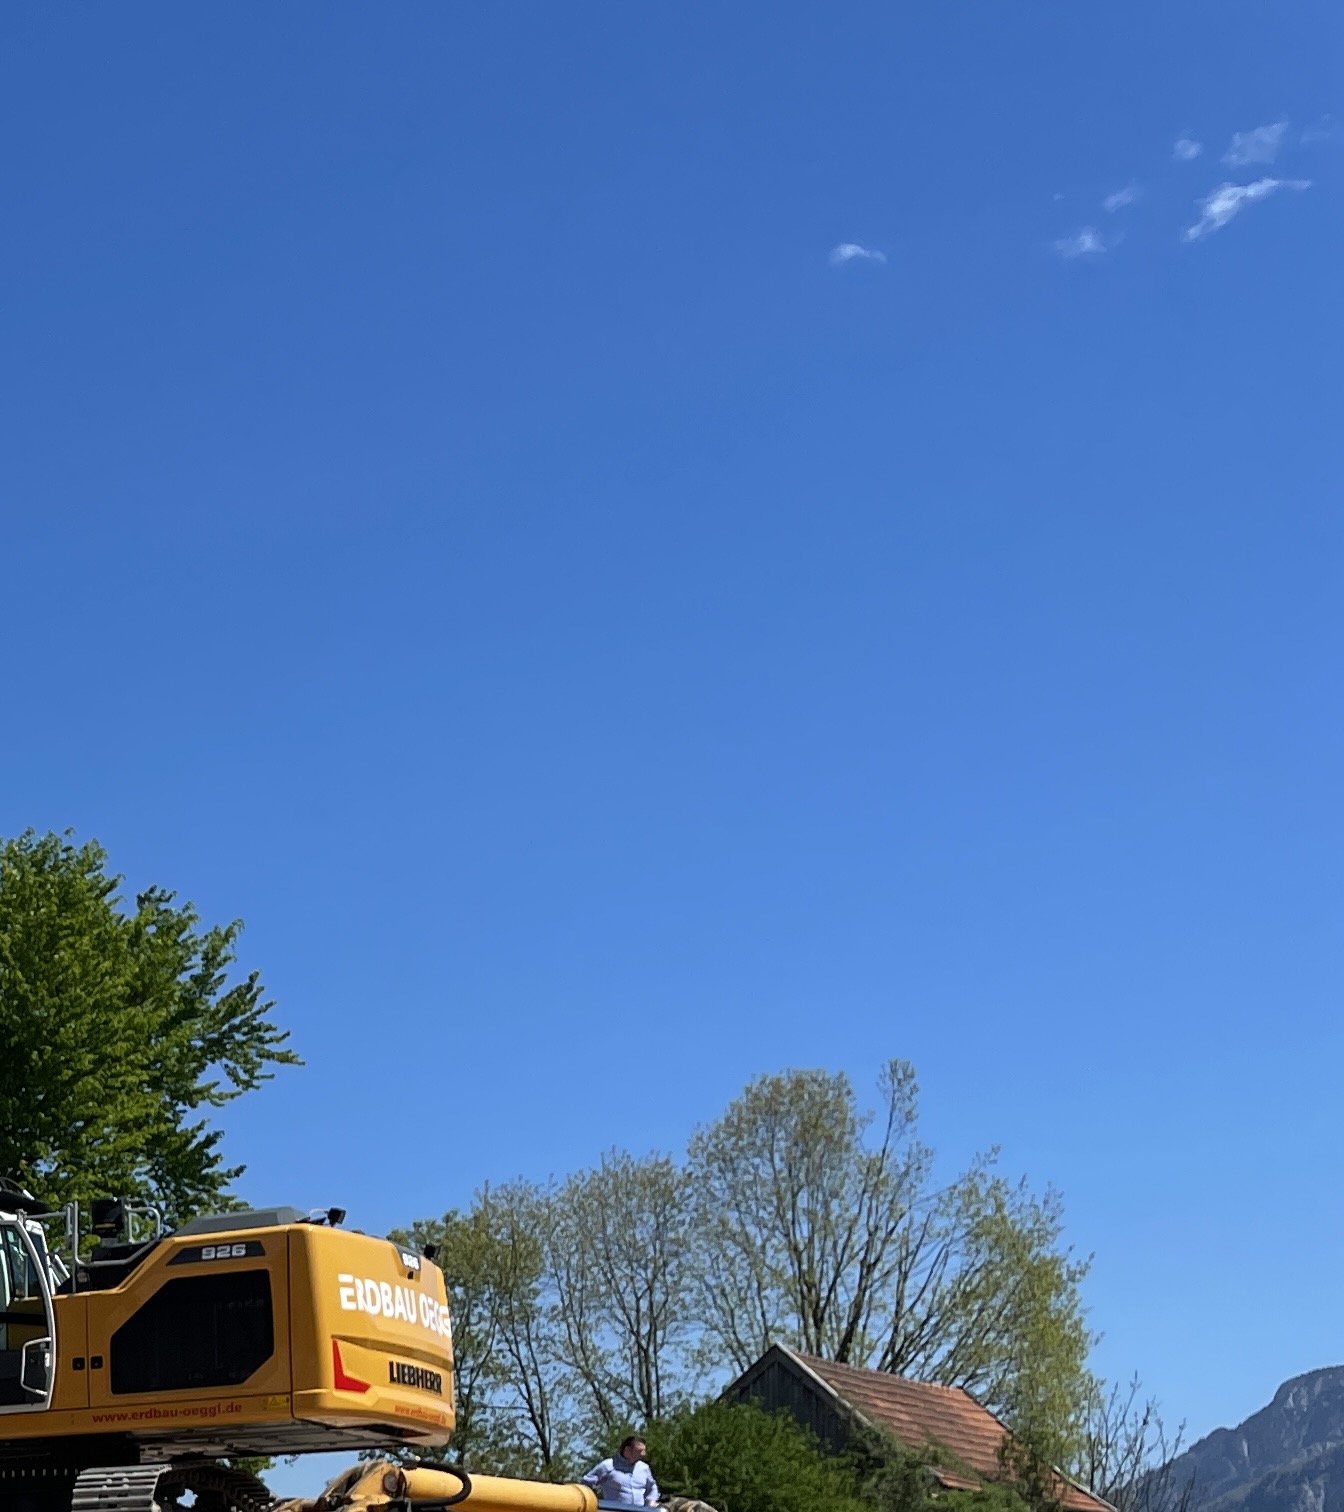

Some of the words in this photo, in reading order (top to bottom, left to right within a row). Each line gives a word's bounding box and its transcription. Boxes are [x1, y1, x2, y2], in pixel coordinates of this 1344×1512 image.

[201, 1244, 247, 1260] 926
[338, 1274, 417, 1324] ERDBAU
[389, 1361, 443, 1395] LIEBHERR
[91, 1402, 243, 1424] www.erdbau-oeggl.de
